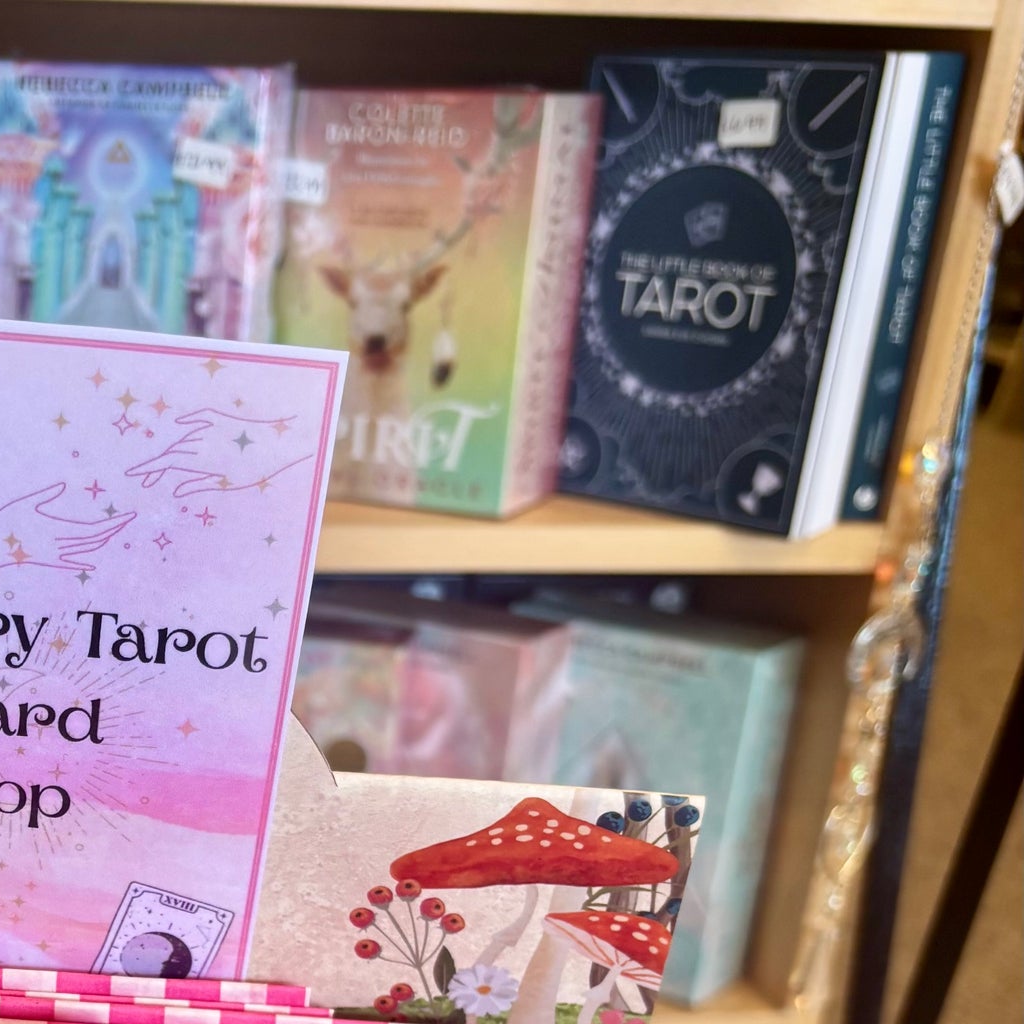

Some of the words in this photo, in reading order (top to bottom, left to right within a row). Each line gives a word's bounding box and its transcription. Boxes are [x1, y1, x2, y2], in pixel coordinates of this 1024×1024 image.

[620, 251, 650, 270] THE
[651, 254, 701, 275] LITTLE
[702, 261, 749, 281] BOOK
[750, 264, 777, 284] OF
[615, 271, 777, 332] TAROT
[337, 402, 502, 472] IRIT
[77, 609, 269, 673] Tarot
[163, 895, 196, 912] XVIII
